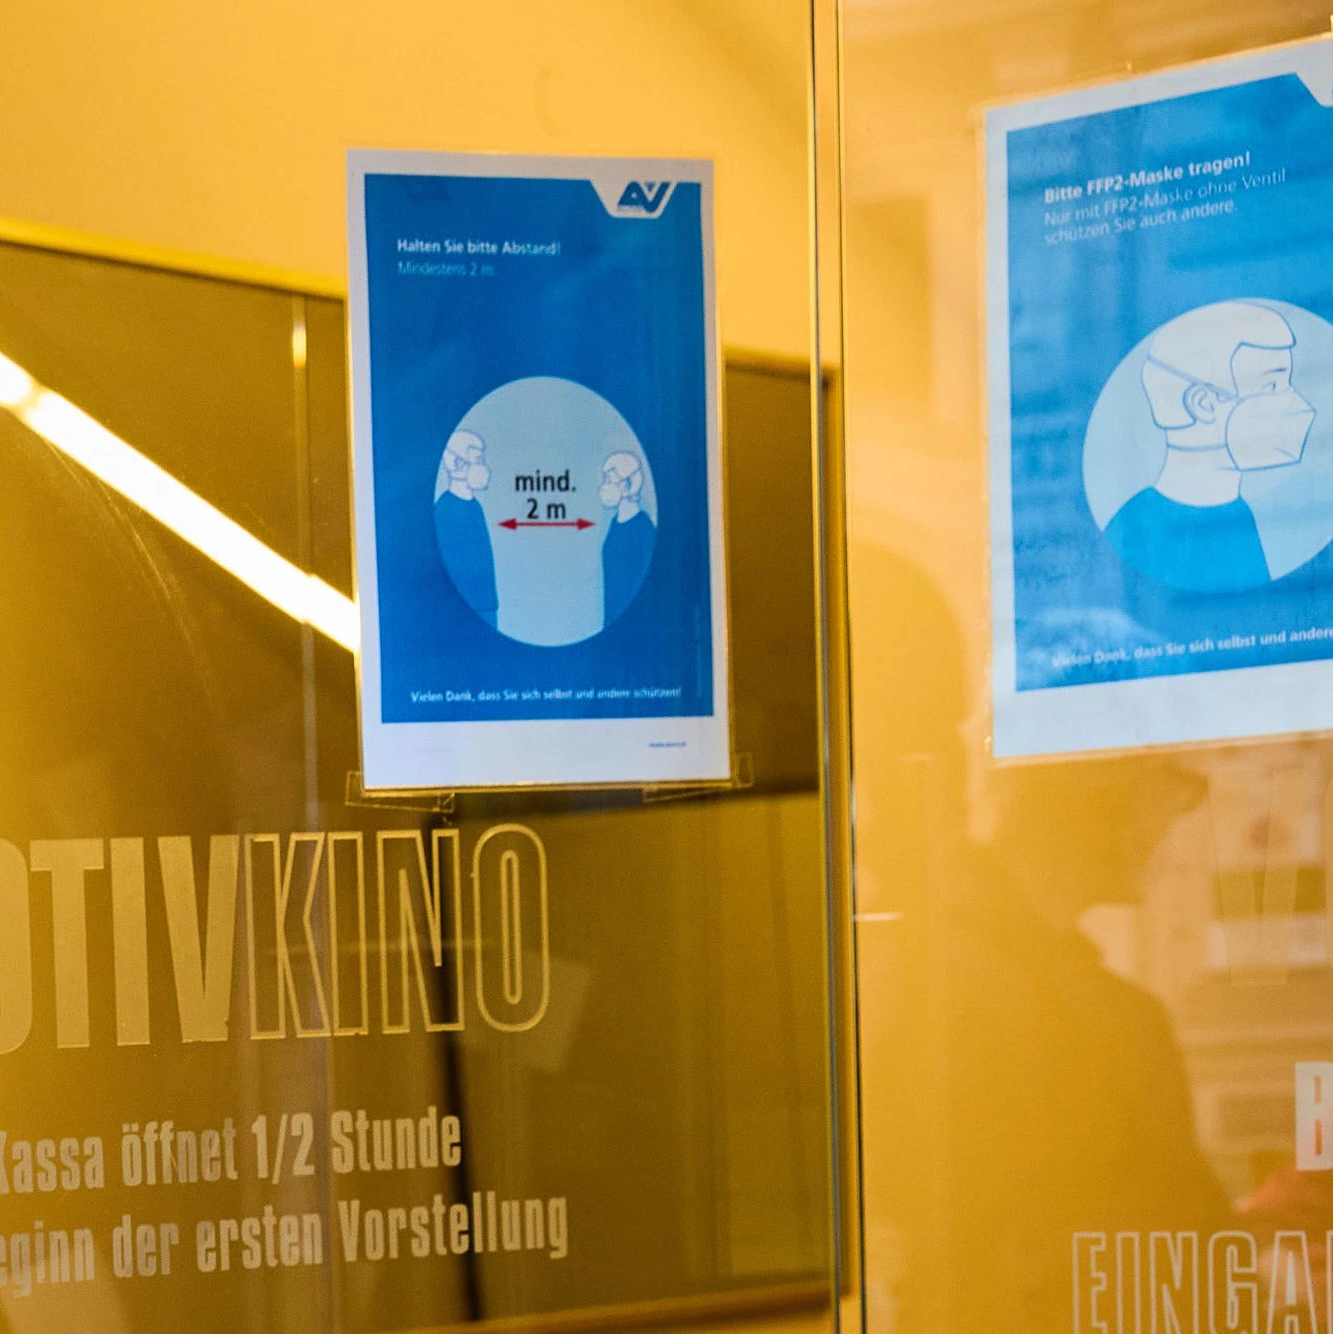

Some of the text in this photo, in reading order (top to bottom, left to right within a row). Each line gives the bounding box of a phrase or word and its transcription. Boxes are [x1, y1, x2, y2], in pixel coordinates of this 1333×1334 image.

[1044, 150, 1251, 204] Bitte FFP2-Maske tragen!
[1044, 168, 1286, 226] Nur mit FFP2-Maske ohne Ventil
[1114, 215, 1136, 232] Sie
[1140, 206, 1177, 228] auch
[397, 238, 441, 253] Halten
[444, 238, 464, 254] Sie
[467, 239, 498, 255] bitte
[469, 261, 478, 276] 2
[515, 469, 577, 492] mind.
[526, 498, 566, 519] 2 m
[1134, 646, 1163, 660] dass
[1166, 642, 1186, 656] Sie
[1189, 639, 1214, 653] sich
[1217, 635, 1255, 651] selbst
[1261, 631, 1286, 647] und
[504, 688, 517, 700] Sie
[121, 1116, 238, 1187] öffnet
[251, 1111, 316, 1186] 1/2
[331, 1104, 462, 1176] Stunde
[111, 1212, 180, 1280] der
[196, 1204, 323, 1273] ersten
[337, 1195, 569, 1263] Vorstellung
